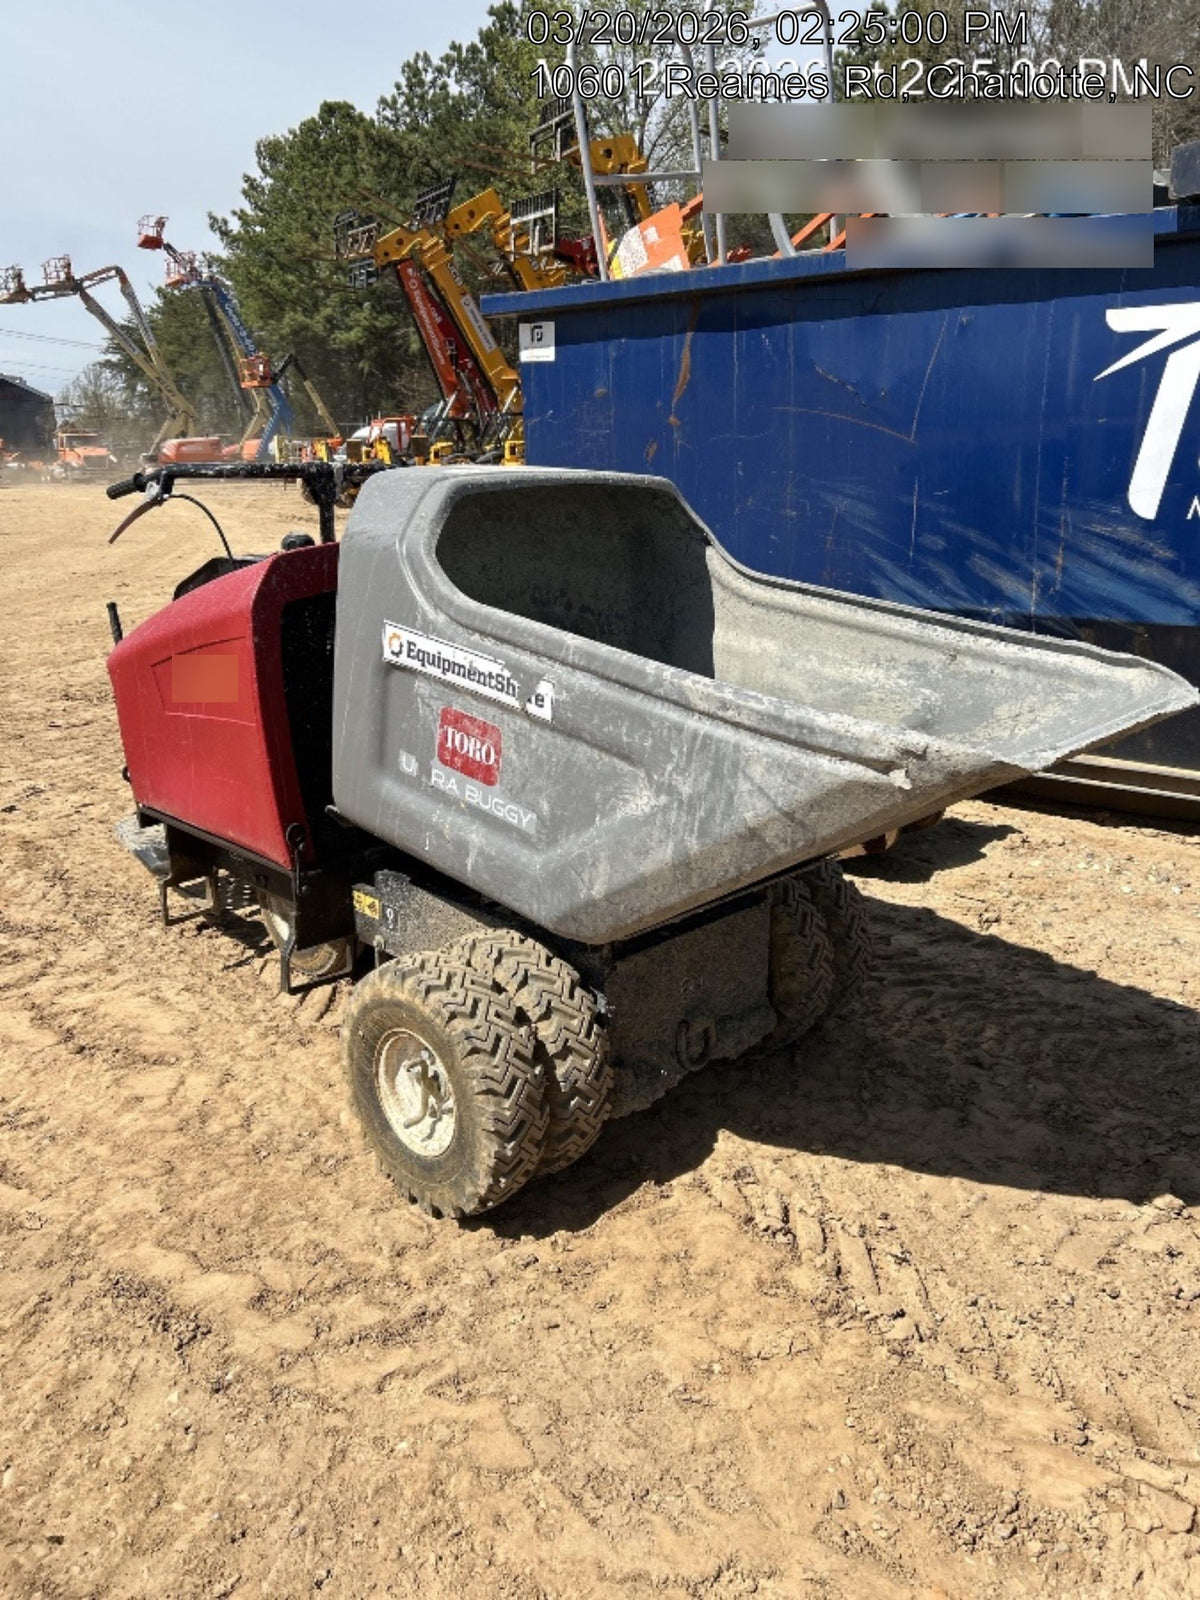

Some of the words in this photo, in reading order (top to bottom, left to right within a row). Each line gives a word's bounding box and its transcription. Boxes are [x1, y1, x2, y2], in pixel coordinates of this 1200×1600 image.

[406, 639, 545, 709] EquipmentShe
[444, 726, 496, 766] TORO
[402, 754, 460, 796] URA
[465, 783, 533, 828] BUGGY
